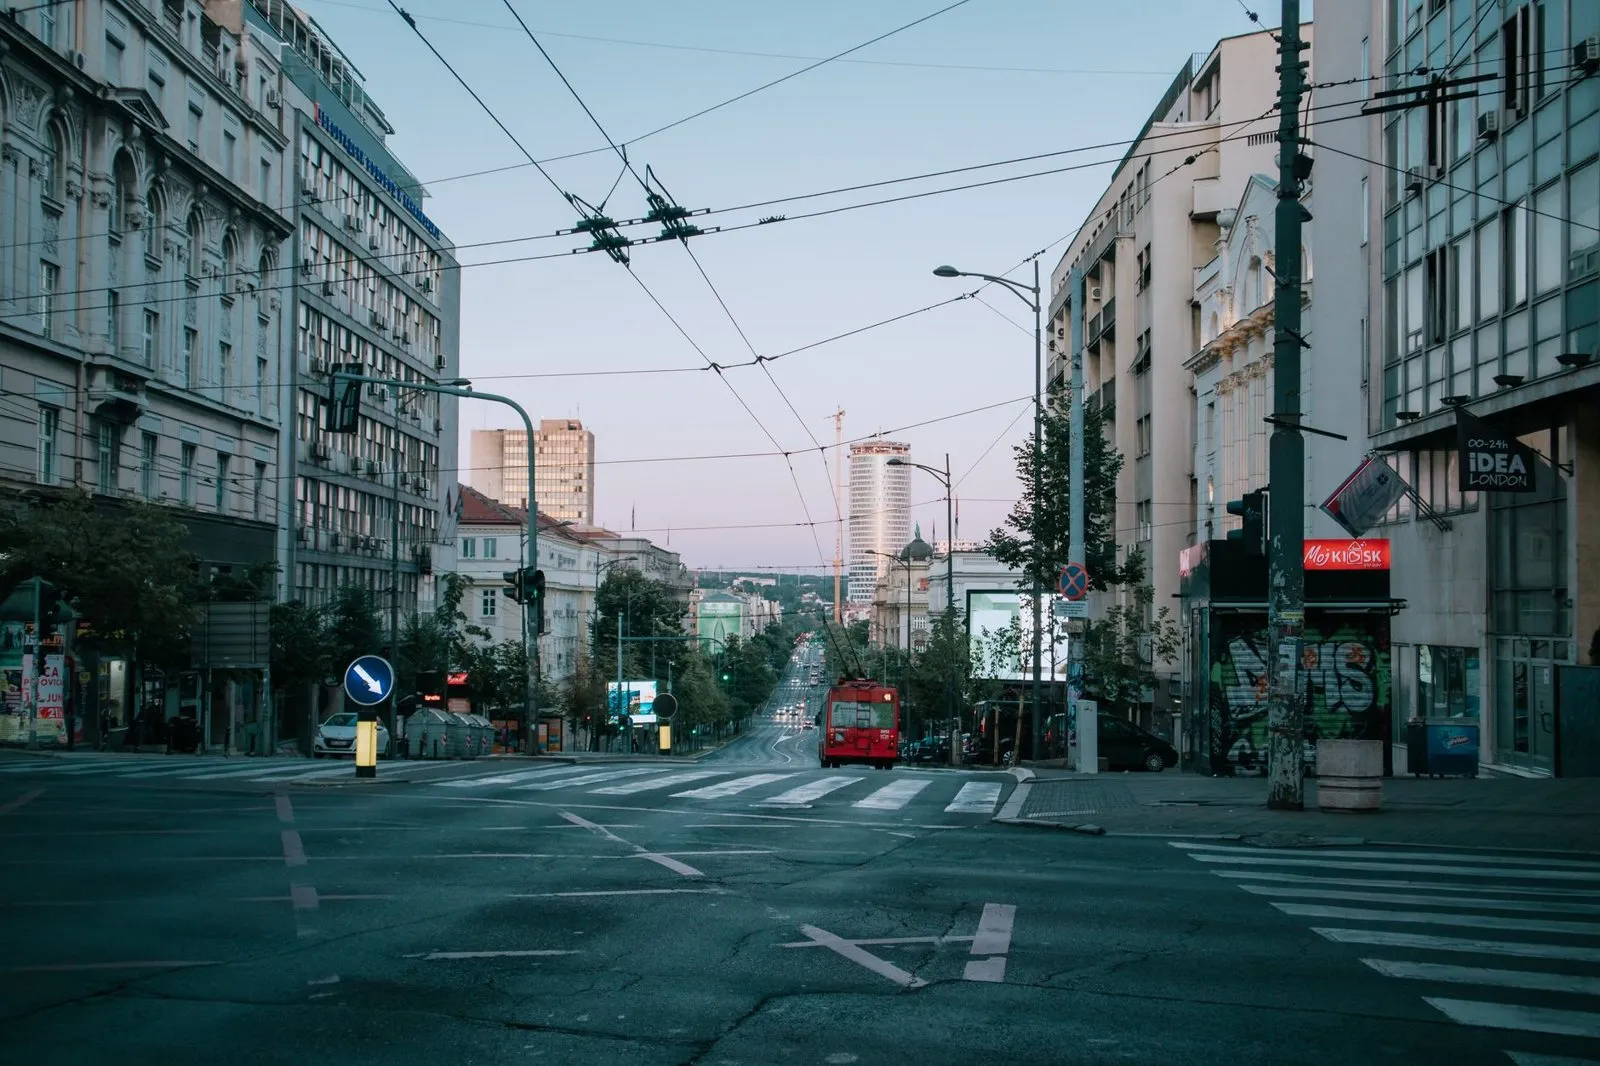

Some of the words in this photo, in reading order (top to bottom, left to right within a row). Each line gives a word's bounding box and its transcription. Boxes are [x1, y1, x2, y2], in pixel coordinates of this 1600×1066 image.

[1469, 473, 1527, 487] LONDON
[1303, 544, 1330, 566] Moj
[1331, 544, 1382, 564] KIOSK
